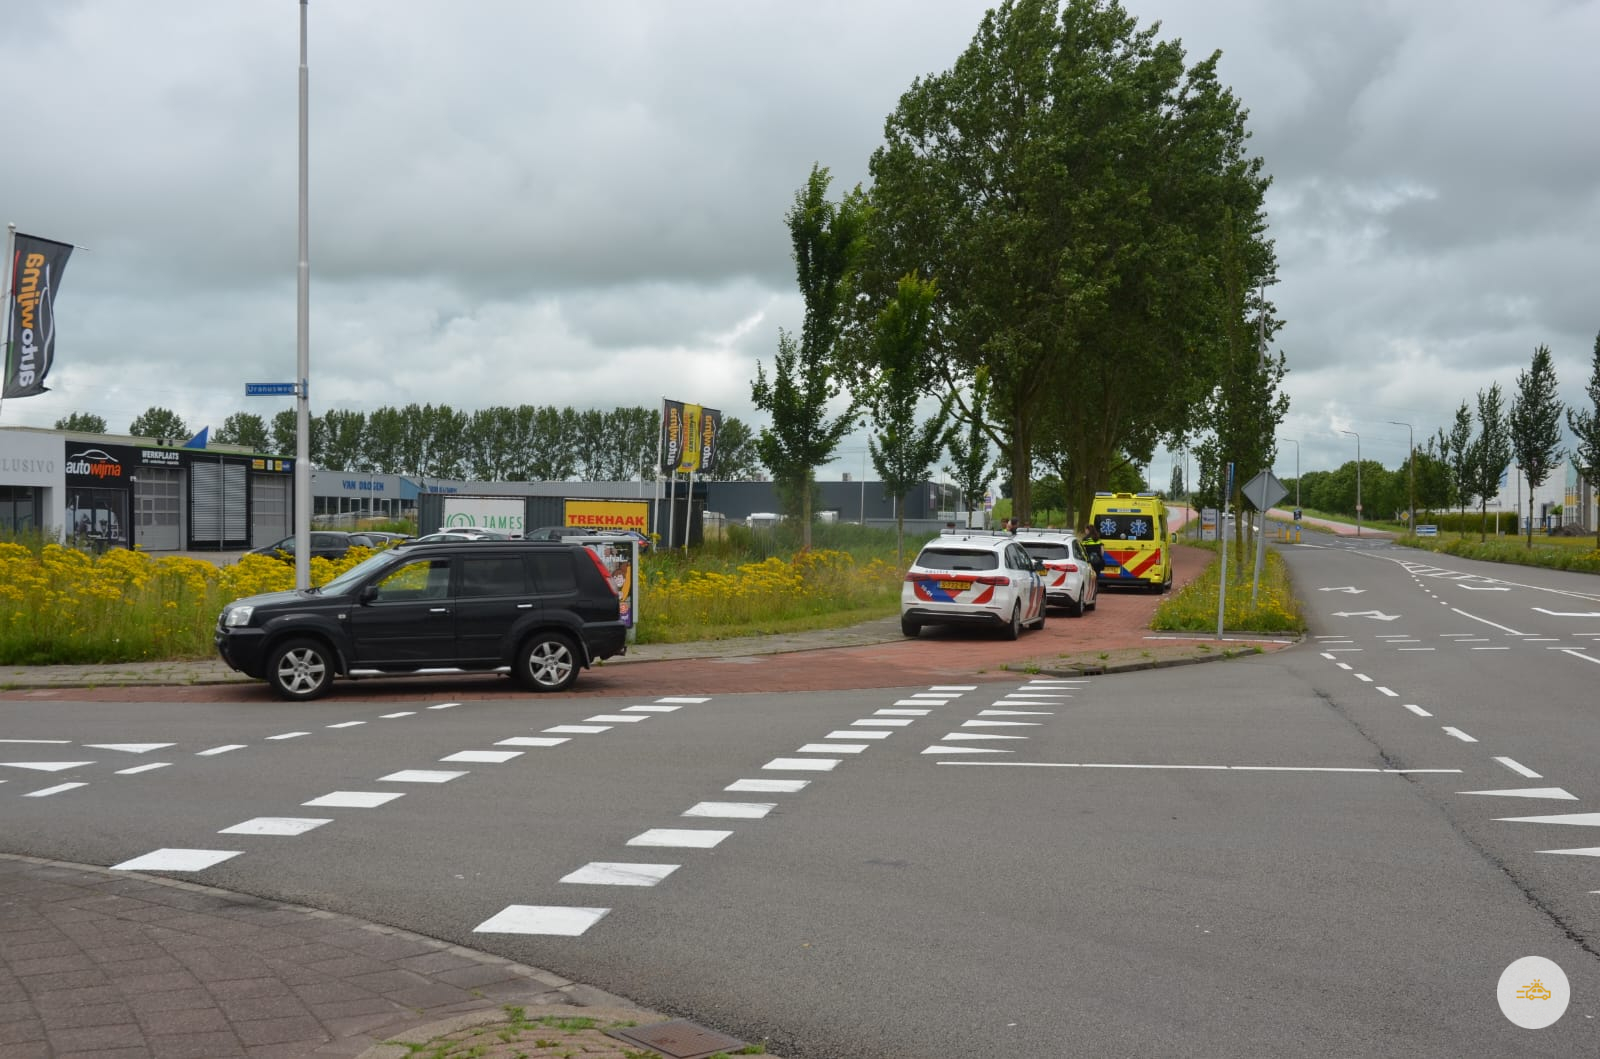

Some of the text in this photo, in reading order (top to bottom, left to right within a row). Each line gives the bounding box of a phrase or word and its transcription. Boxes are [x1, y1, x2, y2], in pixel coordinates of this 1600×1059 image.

[142, 450, 179, 460] WERKPLAATS
[0, 459, 54, 472] LUSIVO
[65, 460, 122, 478] autowijma
[342, 480, 356, 490] VAN
[483, 515, 523, 529] JAMES
[568, 514, 645, 526] TREKHAAK
